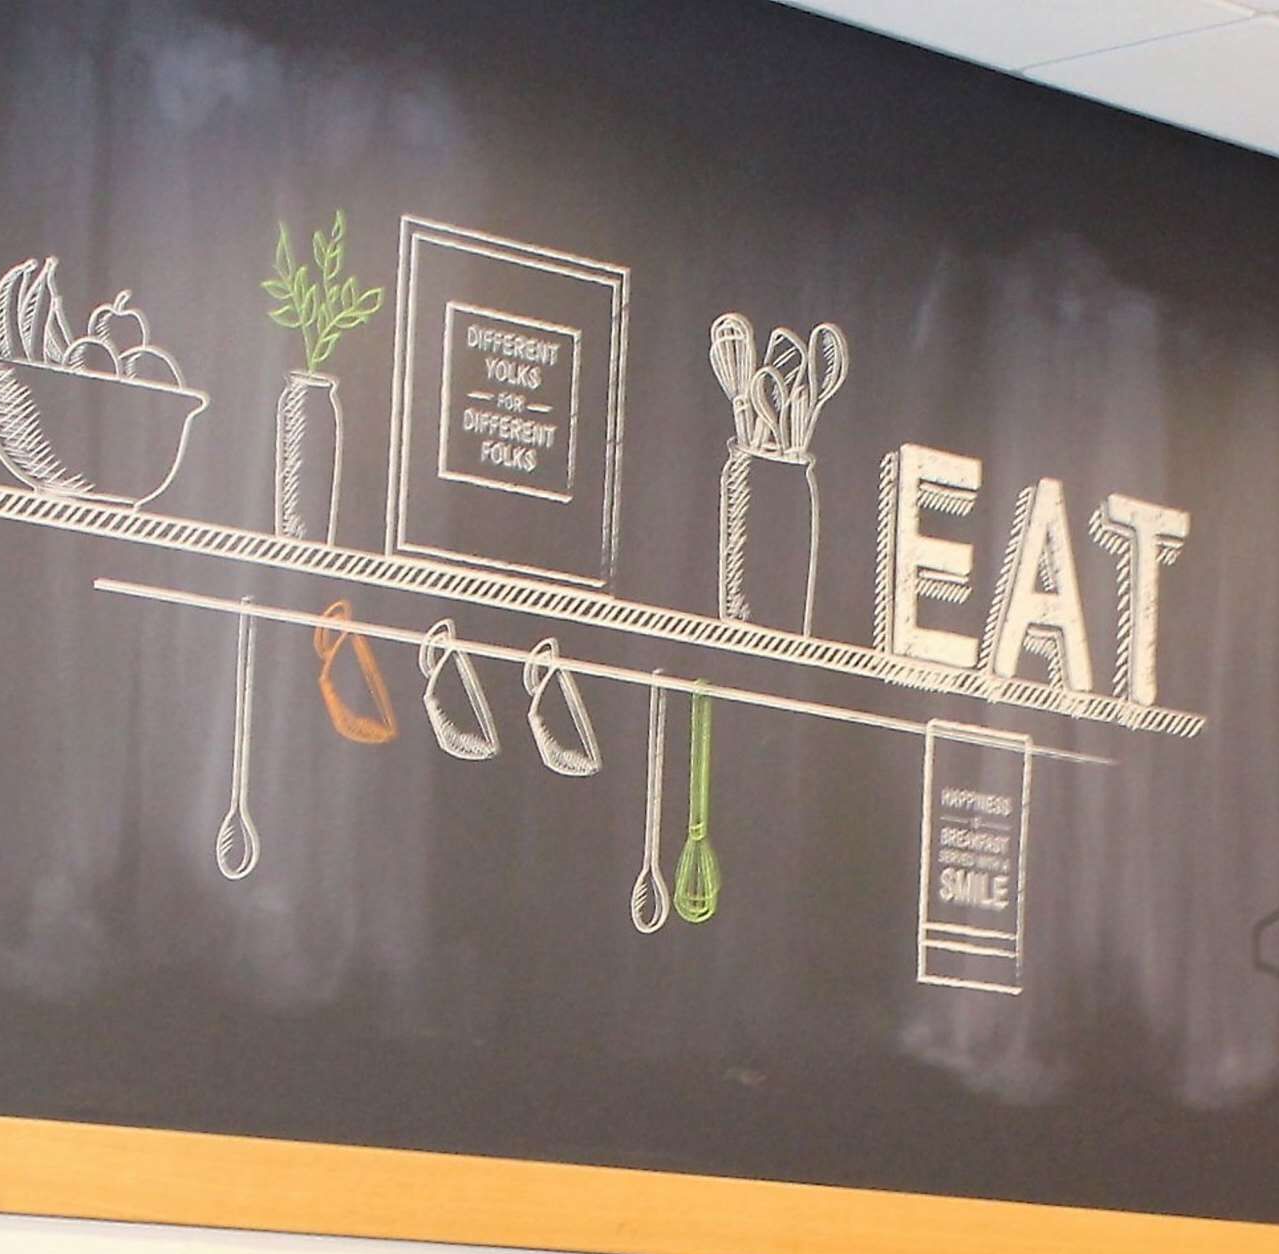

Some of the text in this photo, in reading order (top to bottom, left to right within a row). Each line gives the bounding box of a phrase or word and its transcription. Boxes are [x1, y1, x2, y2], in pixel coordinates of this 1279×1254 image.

[467, 324, 560, 366] DIFFERENT
[485, 356, 542, 389] YOLKS
[497, 391, 526, 413] FOR
[463, 408, 557, 448] DIFFERENT
[481, 440, 537, 472] FOLKS
[874, 443, 1191, 708] EAT
[941, 788, 1012, 816] HAPPINESS
[940, 828, 1009, 854] BREAKFAST
[939, 867, 1010, 910] SMILE
